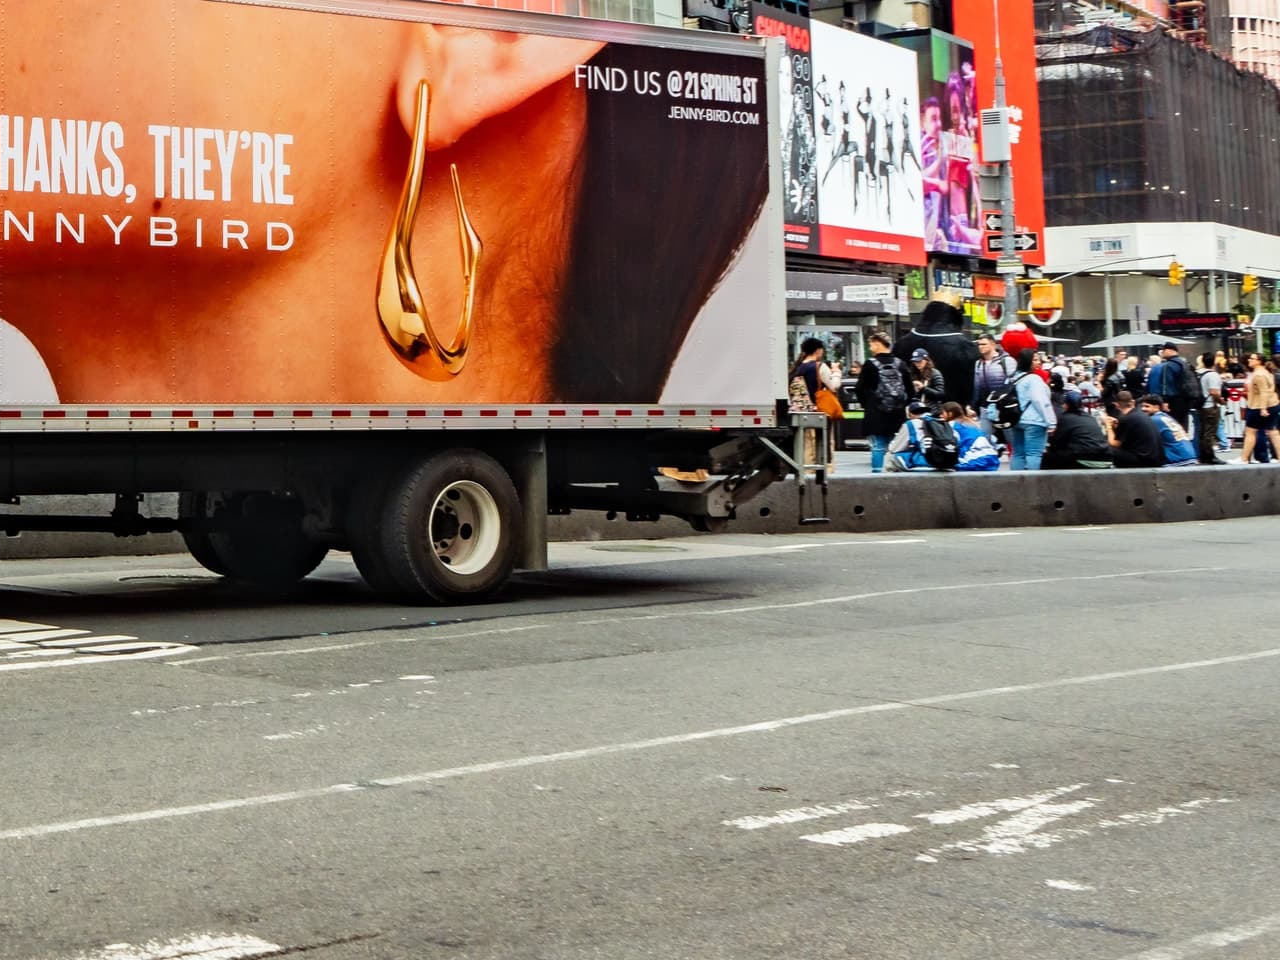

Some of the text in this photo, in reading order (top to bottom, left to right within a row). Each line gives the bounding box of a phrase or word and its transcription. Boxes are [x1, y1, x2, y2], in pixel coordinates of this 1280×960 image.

[575, 64, 627, 91] FIND
[634, 69, 661, 96] US
[667, 70, 682, 97] @
[701, 73, 741, 103] SPRING
[743, 77, 759, 104] ST
[668, 106, 760, 125] JENNY-BIRD.COM
[148, 124, 295, 205] THEY'RE
